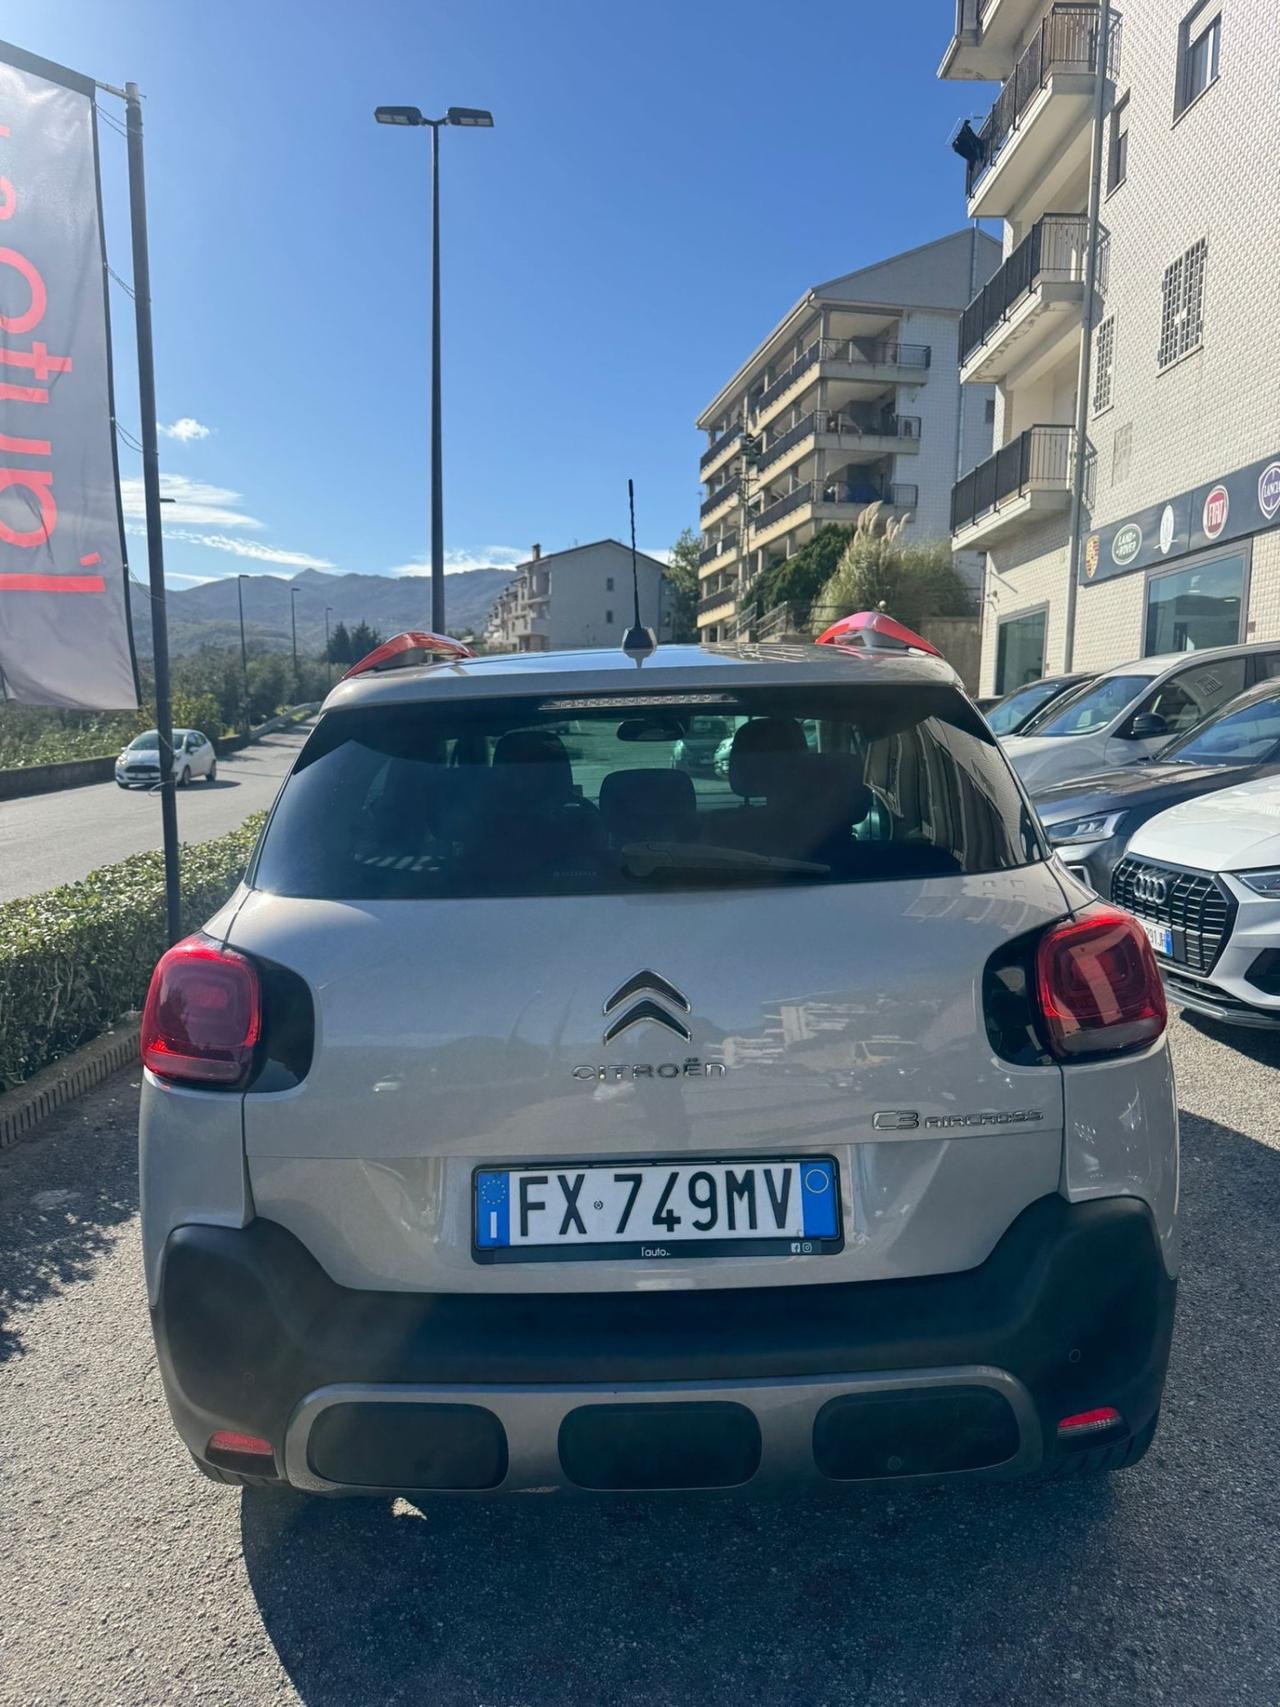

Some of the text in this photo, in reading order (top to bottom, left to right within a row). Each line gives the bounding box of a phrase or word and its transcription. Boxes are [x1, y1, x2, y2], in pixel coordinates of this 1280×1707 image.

[1208, 499, 1224, 527] FIAT
[1118, 532, 1134, 546] LAND
[1119, 540, 1136, 556] ROVER
[571, 1057, 727, 1081] CITROËN
[872, 1108, 1045, 1131] C3 AIRCROSS
